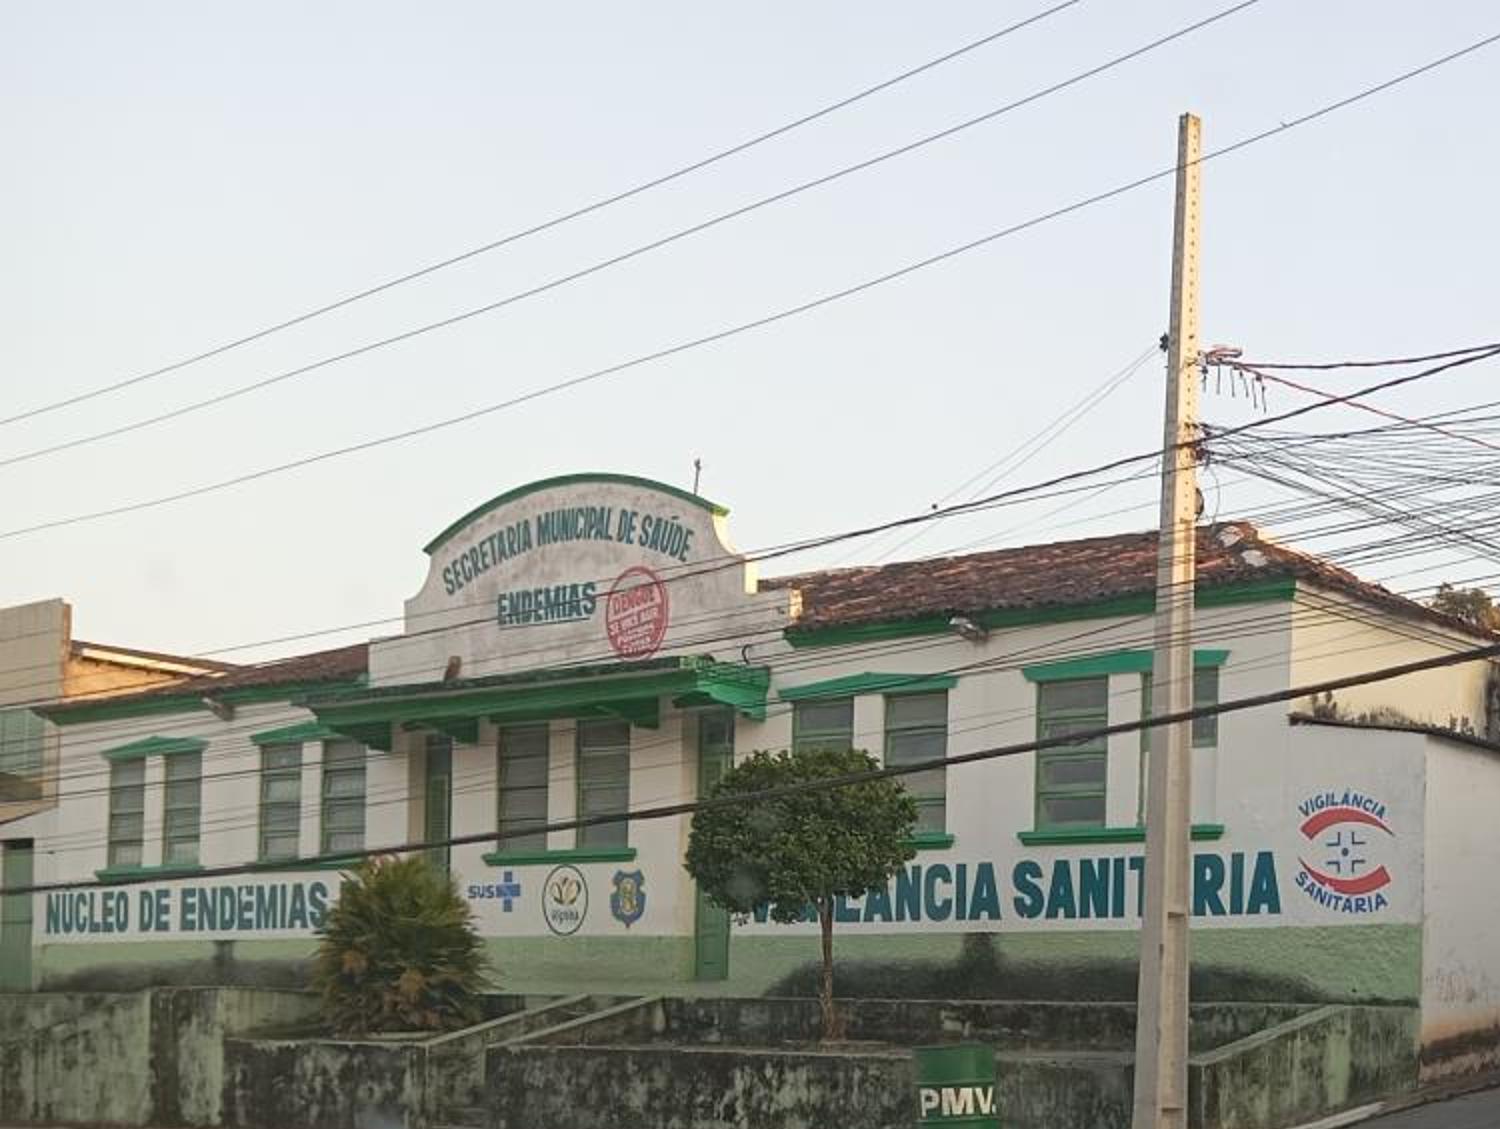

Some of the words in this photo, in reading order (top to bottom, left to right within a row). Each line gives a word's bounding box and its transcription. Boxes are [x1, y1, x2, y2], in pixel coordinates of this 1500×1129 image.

[442, 519, 533, 596] SECRETARIA
[537, 506, 613, 547] MUNICIPAL
[616, 508, 639, 545] DE
[497, 581, 597, 626] ENDEMIAS
[139, 889, 170, 933] DE
[180, 881, 328, 931] ENDEMIAS
[1012, 851, 1281, 919] SANITRIA
